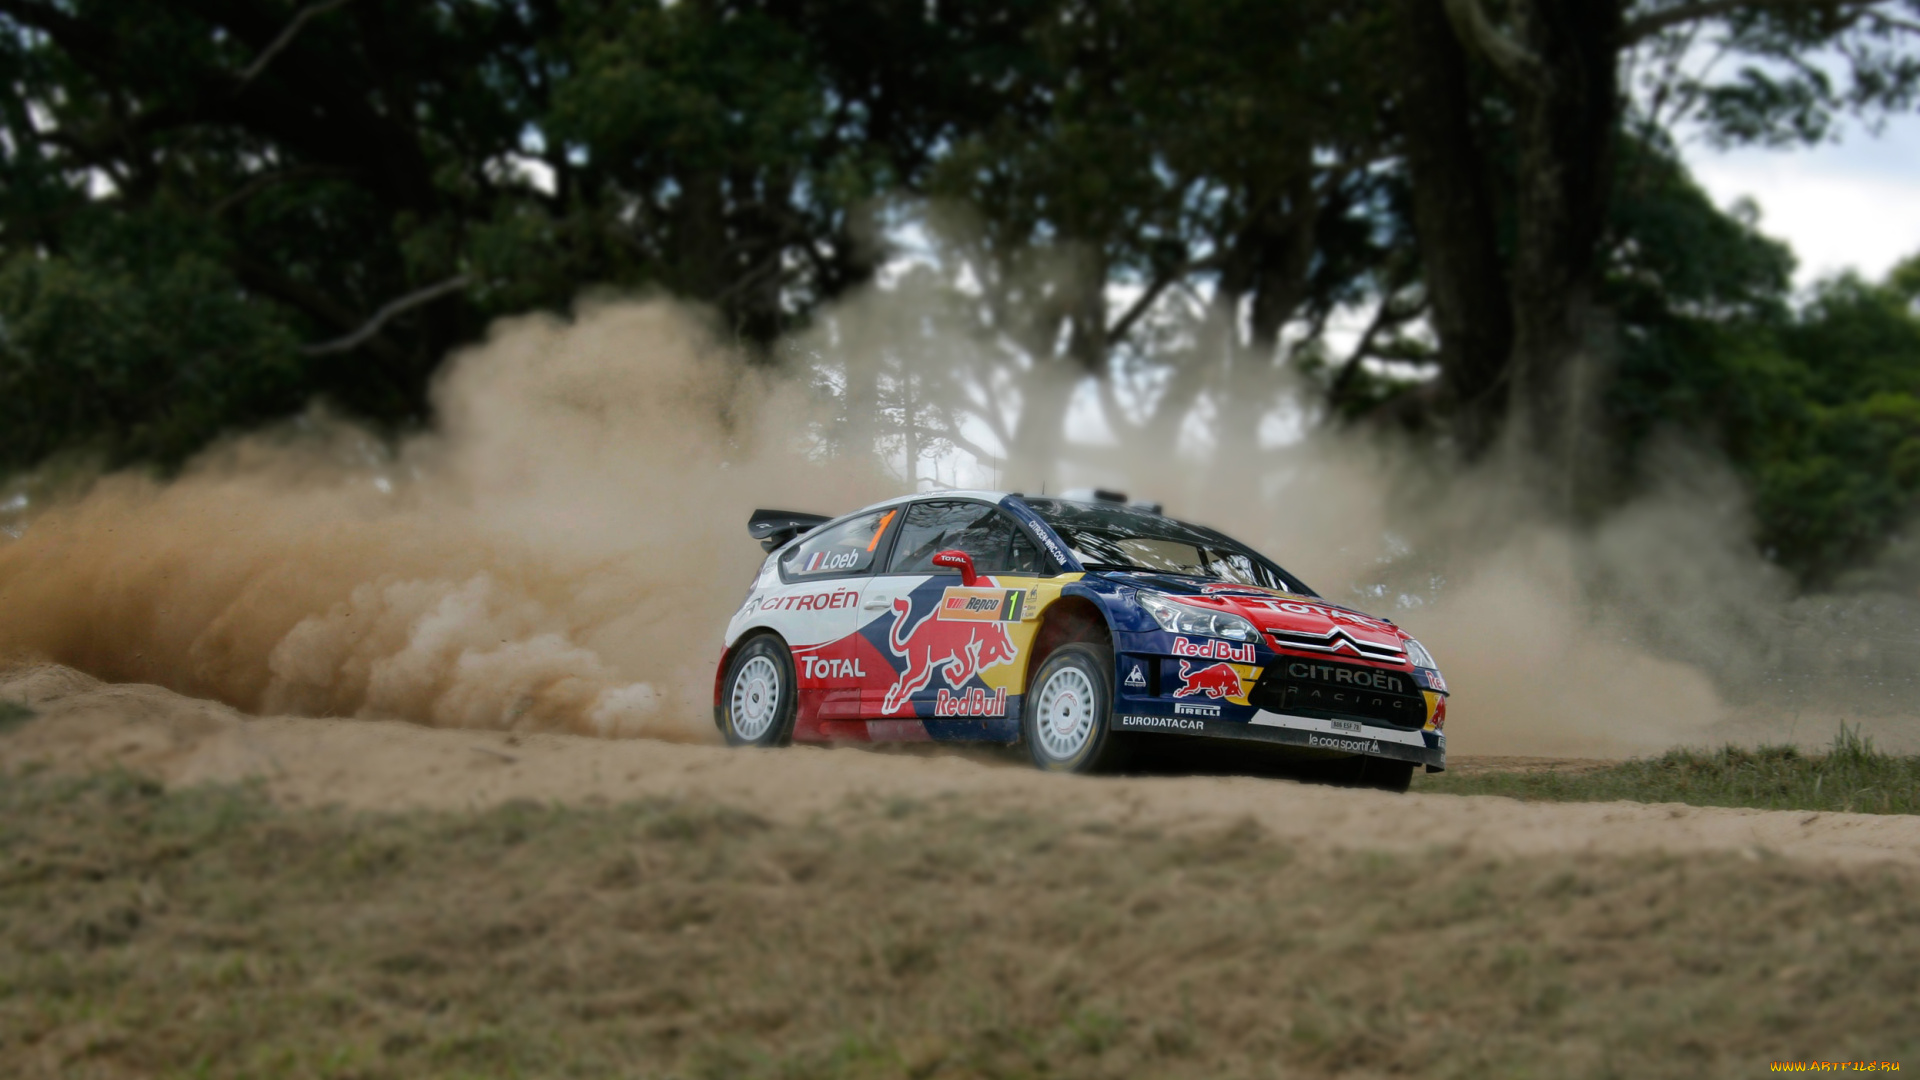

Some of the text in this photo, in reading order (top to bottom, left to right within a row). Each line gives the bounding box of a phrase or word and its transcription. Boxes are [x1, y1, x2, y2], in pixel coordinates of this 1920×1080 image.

[867, 509, 897, 552] 1
[820, 549, 859, 570] Loeb
[940, 555, 966, 563] TOTAL
[965, 597, 999, 611] Repco
[1008, 591, 1019, 620] 1
[1252, 599, 1379, 628] TOTAL
[1171, 636, 1256, 663] Red Bull
[801, 655, 866, 679] TOTAL
[935, 687, 1007, 716] Red Bull
[1287, 686, 1403, 708] RACING
[1174, 703, 1221, 717] PIRELLI
[1123, 716, 1204, 730] EURODATACAR
[1309, 733, 1371, 752] le coq sportif
